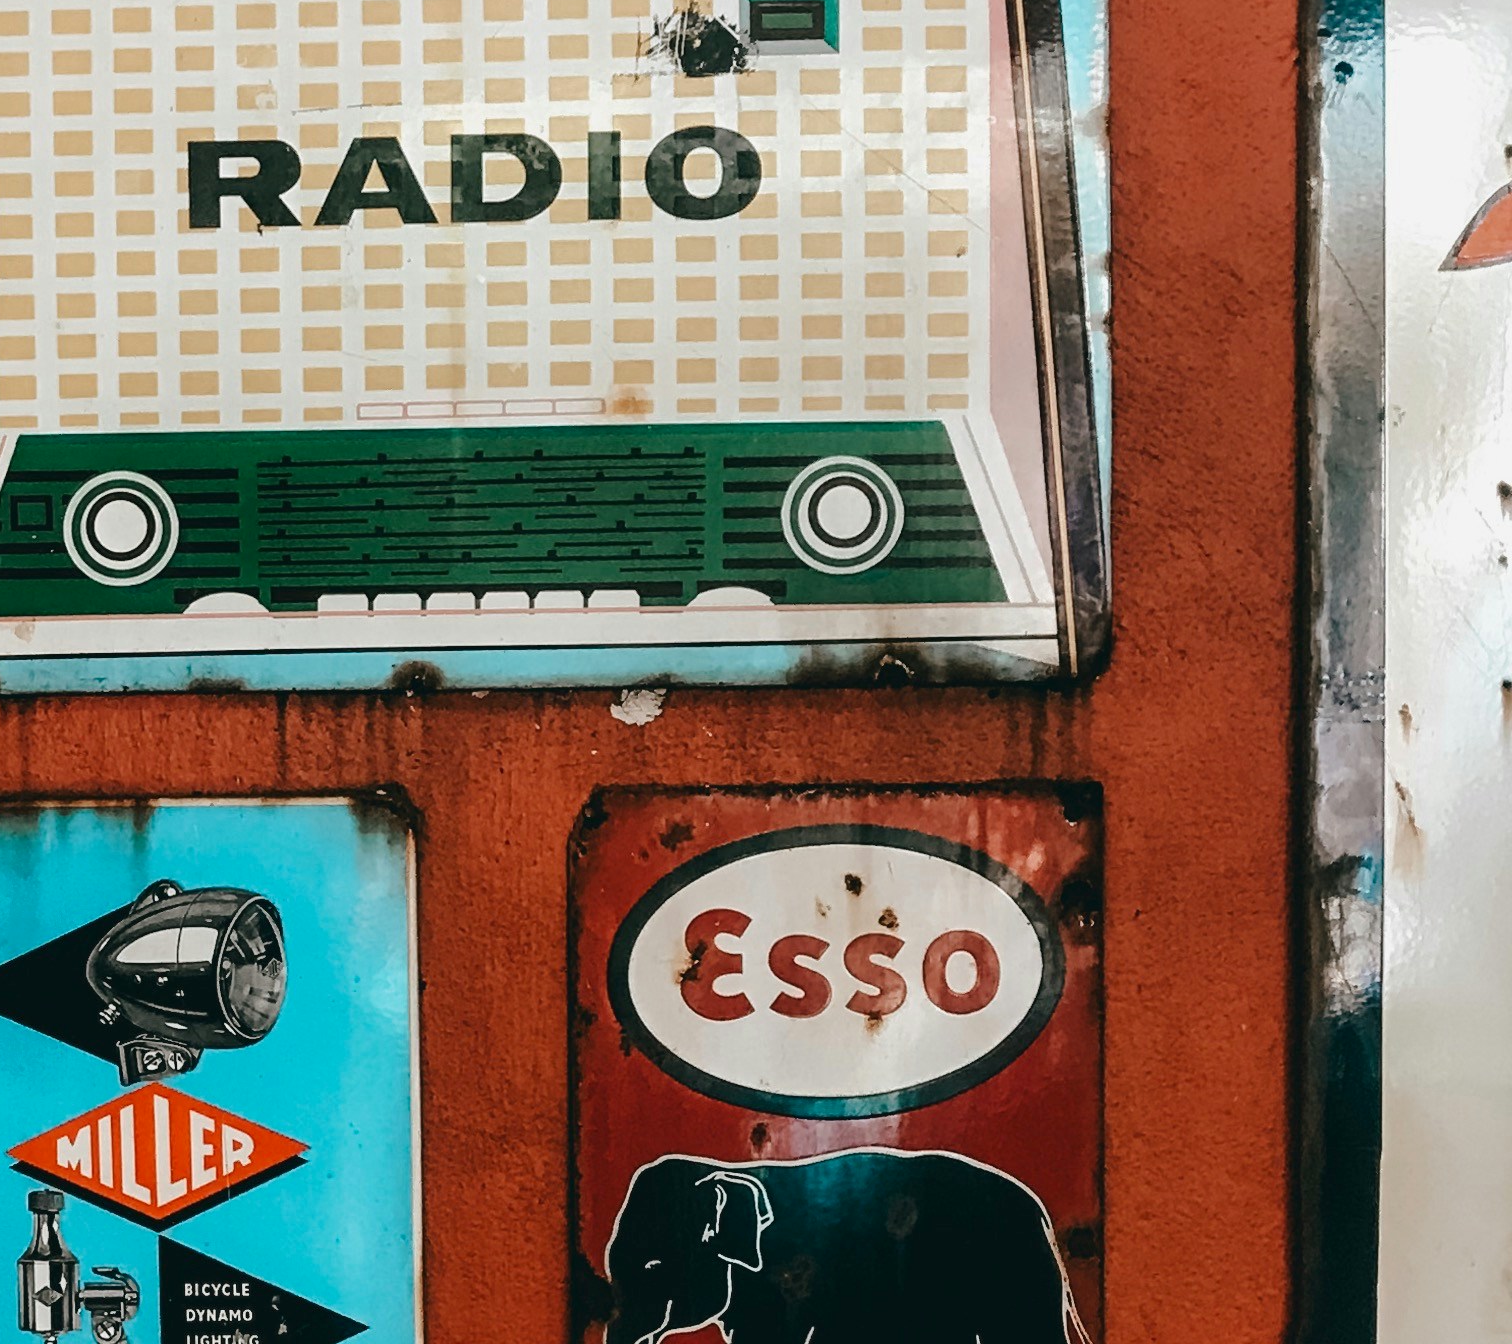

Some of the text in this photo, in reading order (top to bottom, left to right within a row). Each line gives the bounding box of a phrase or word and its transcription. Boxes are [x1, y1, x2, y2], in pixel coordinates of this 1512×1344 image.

[186, 123, 764, 232] RADIO
[55, 1093, 256, 1208] MILLER
[184, 1282, 251, 1297] BICYCLE
[185, 1308, 254, 1322] DYNAMO
